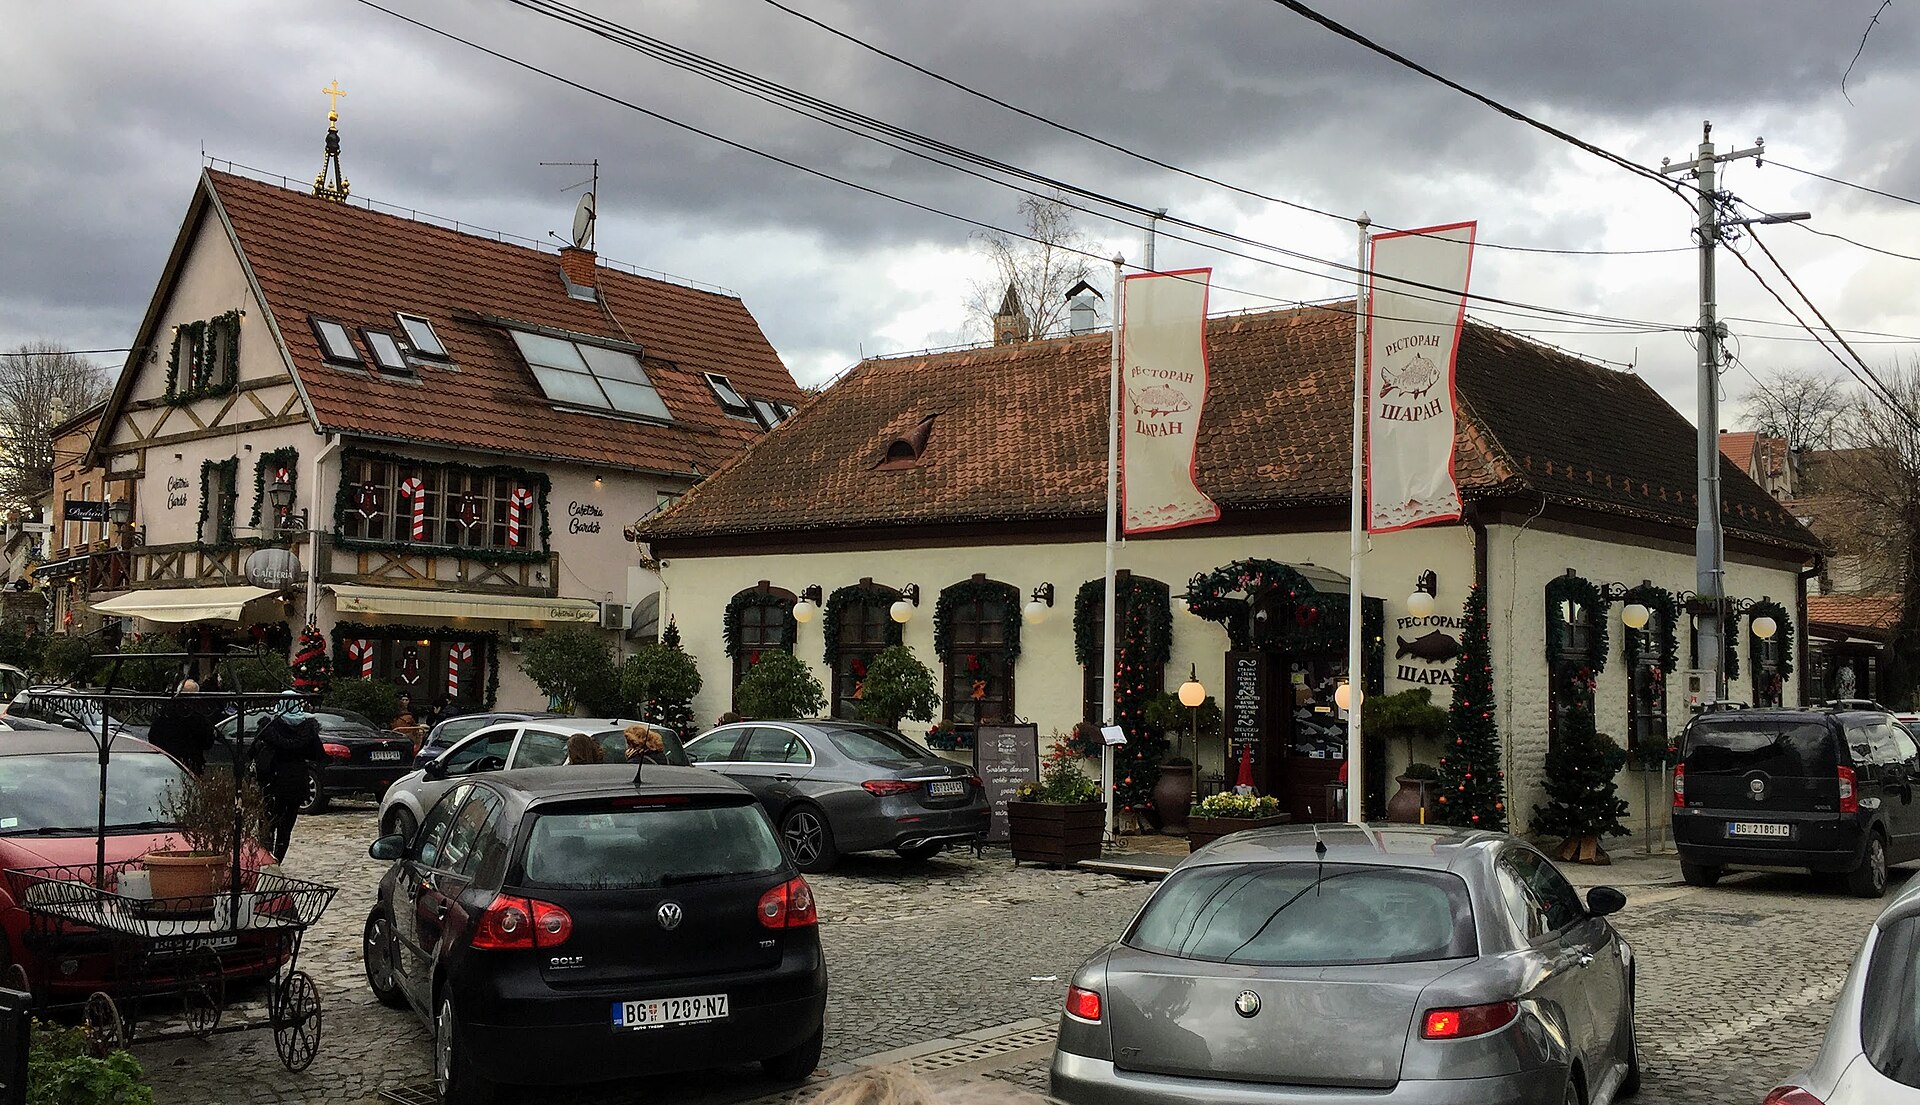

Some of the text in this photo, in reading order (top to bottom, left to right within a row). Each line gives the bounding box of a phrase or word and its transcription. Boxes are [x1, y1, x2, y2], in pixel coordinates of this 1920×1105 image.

[1131, 366, 1194, 383] РЕСТОРАН
[1380, 398, 1443, 421] ШАРАН
[1397, 615, 1464, 629] РЕСТОРАН
[1736, 823, 1747, 833] BG
[759, 939, 775, 948] TDI
[550, 956, 583, 965] GOLF
[626, 1003, 647, 1023] BG
